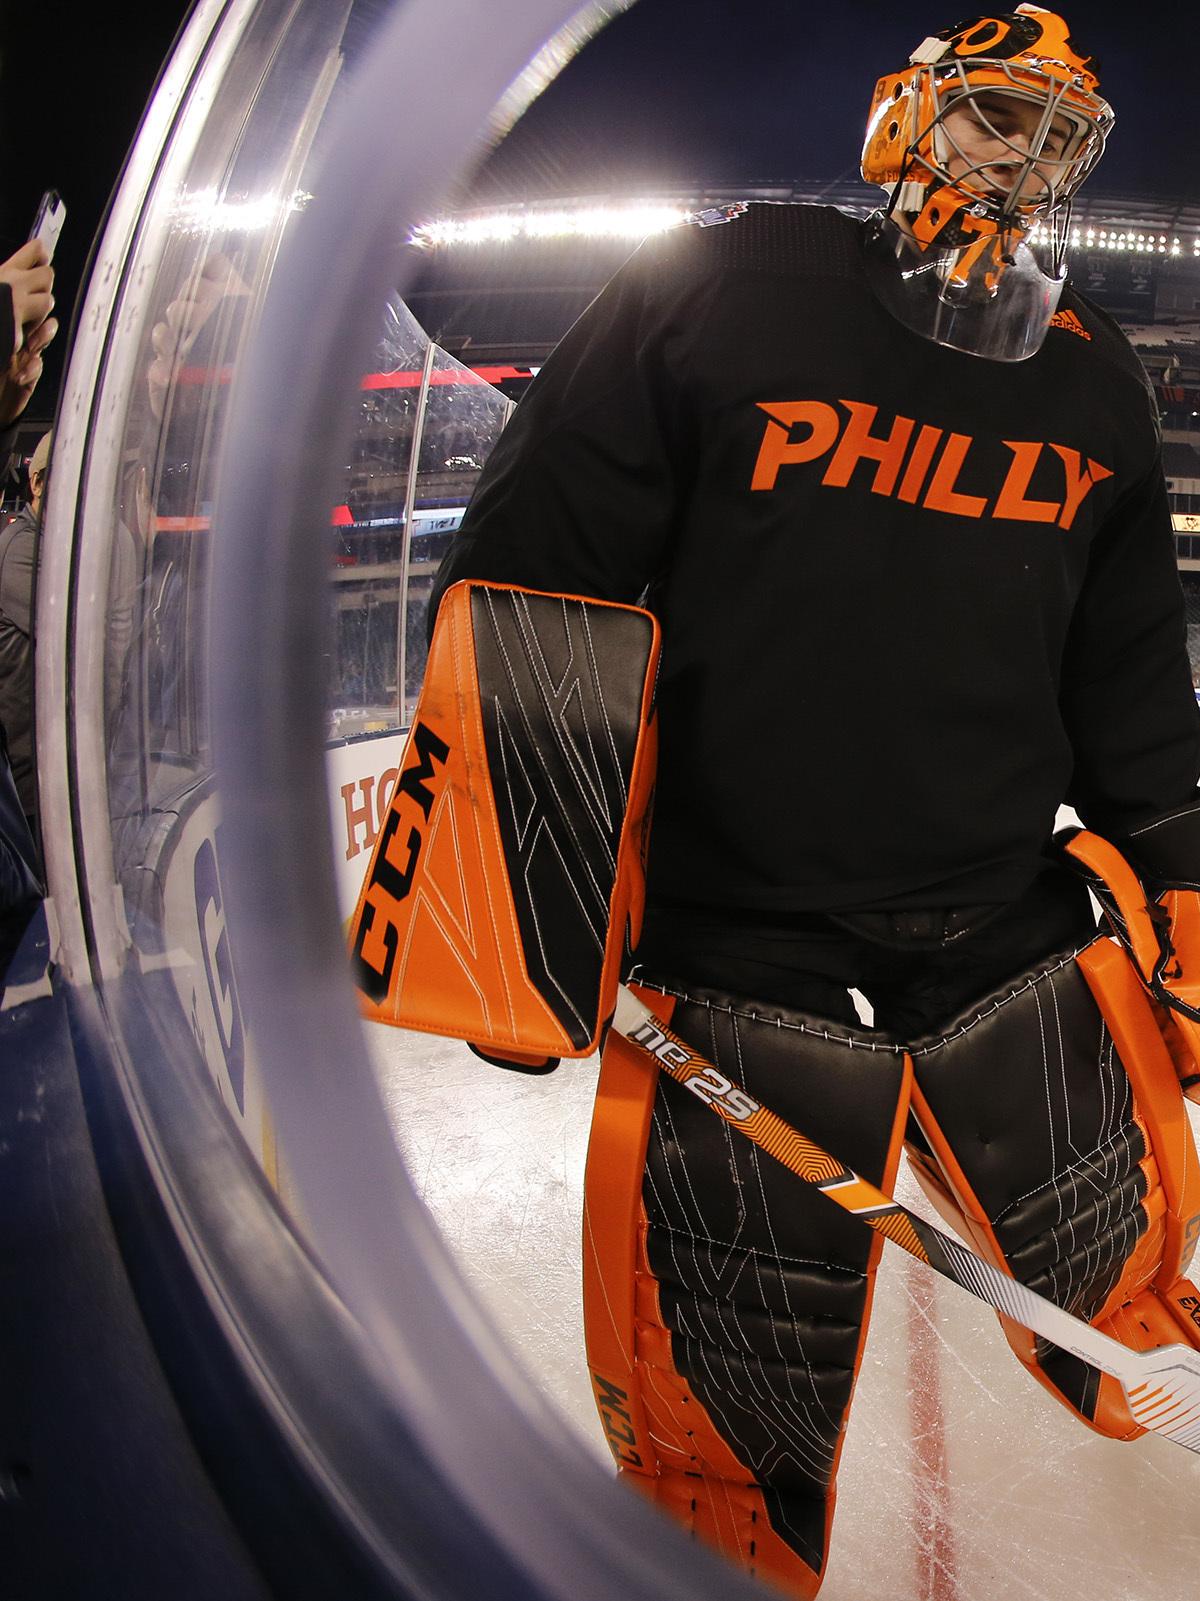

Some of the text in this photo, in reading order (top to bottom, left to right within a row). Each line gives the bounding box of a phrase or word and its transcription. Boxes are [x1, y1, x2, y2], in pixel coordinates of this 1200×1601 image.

[750, 399, 1115, 531] PHILLY
[352, 721, 450, 1007] CCM
[683, 1067, 761, 1121] 2S
